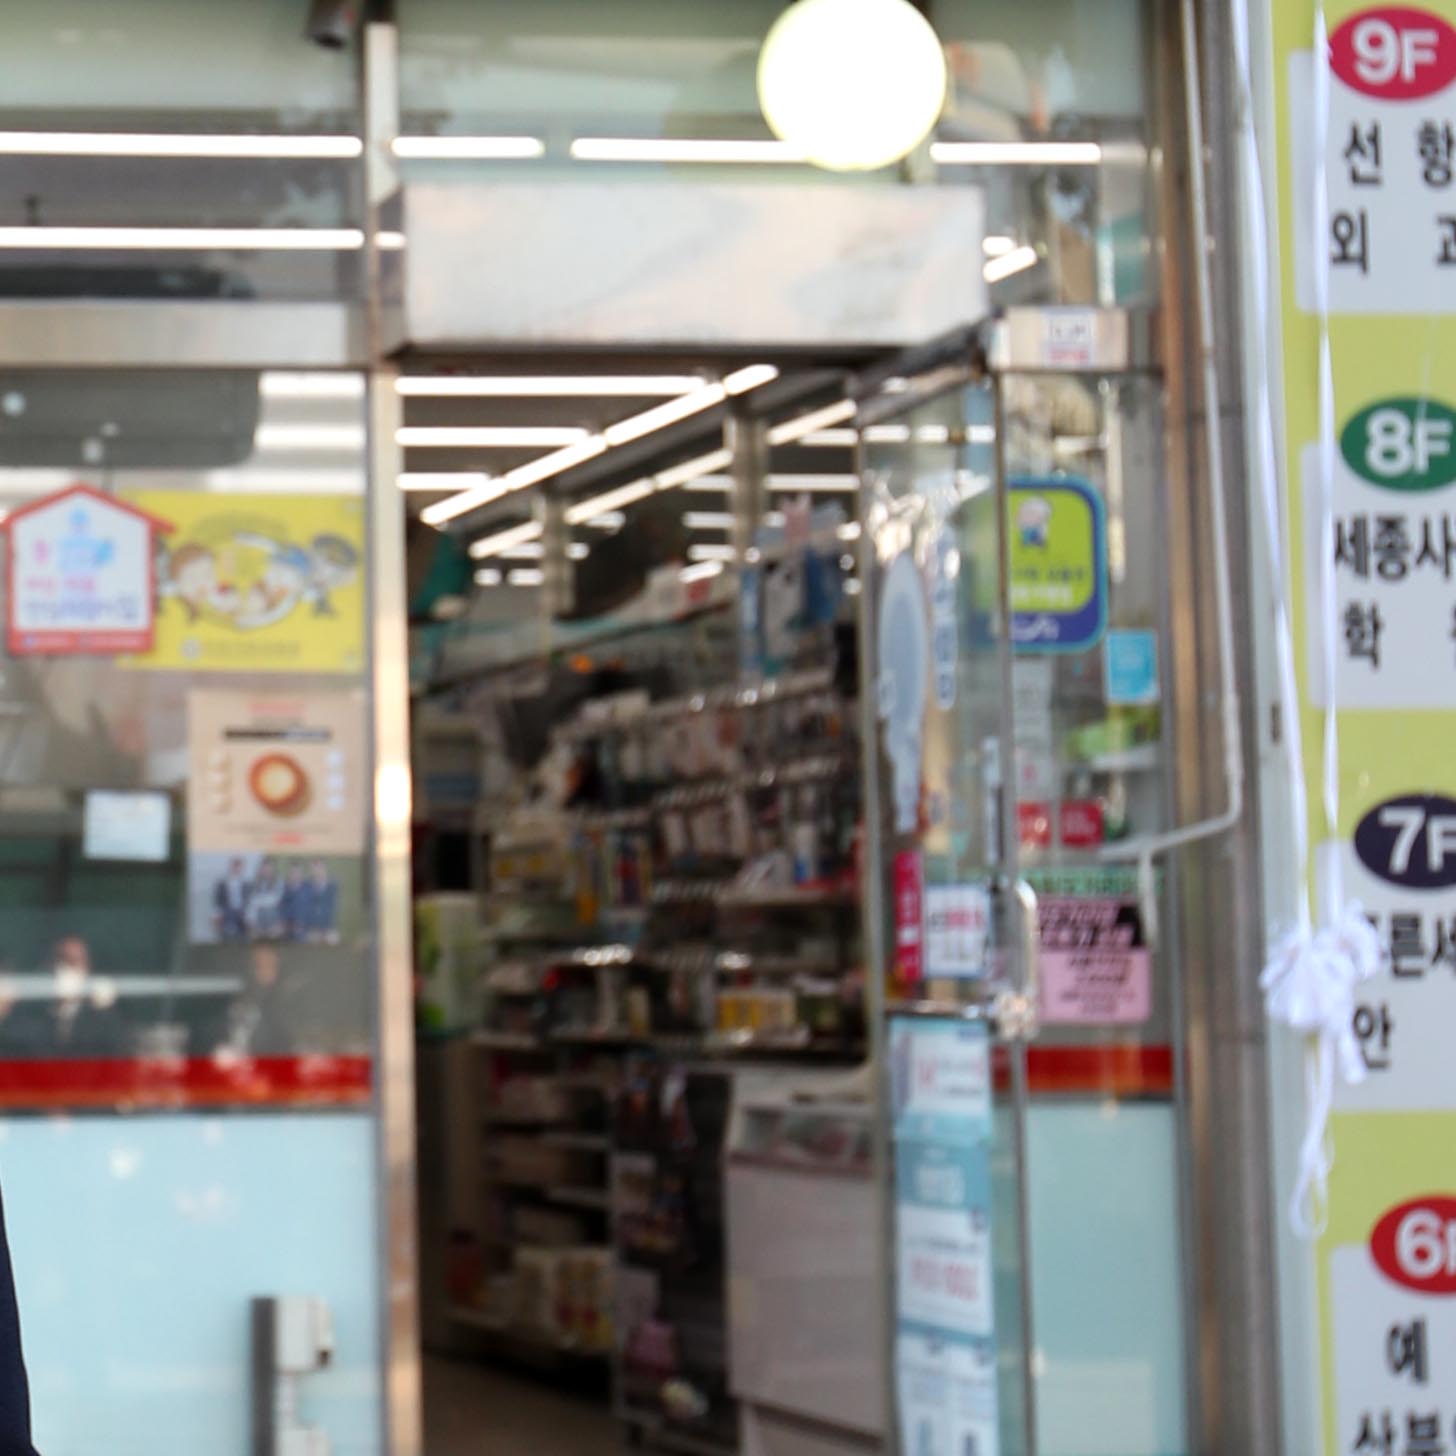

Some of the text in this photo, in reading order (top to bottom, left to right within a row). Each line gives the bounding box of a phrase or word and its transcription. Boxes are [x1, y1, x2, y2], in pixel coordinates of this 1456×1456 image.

[1350, 17, 1440, 85] 9F
[1330, 208, 1369, 275] 외
[1364, 406, 1453, 477] 8F
[1343, 600, 1383, 672] 학
[1377, 805, 1456, 875] 7F
[1352, 1001, 1394, 1070] 안
[1395, 1208, 1456, 1279] 6
[1385, 1318, 1428, 1384] 예
